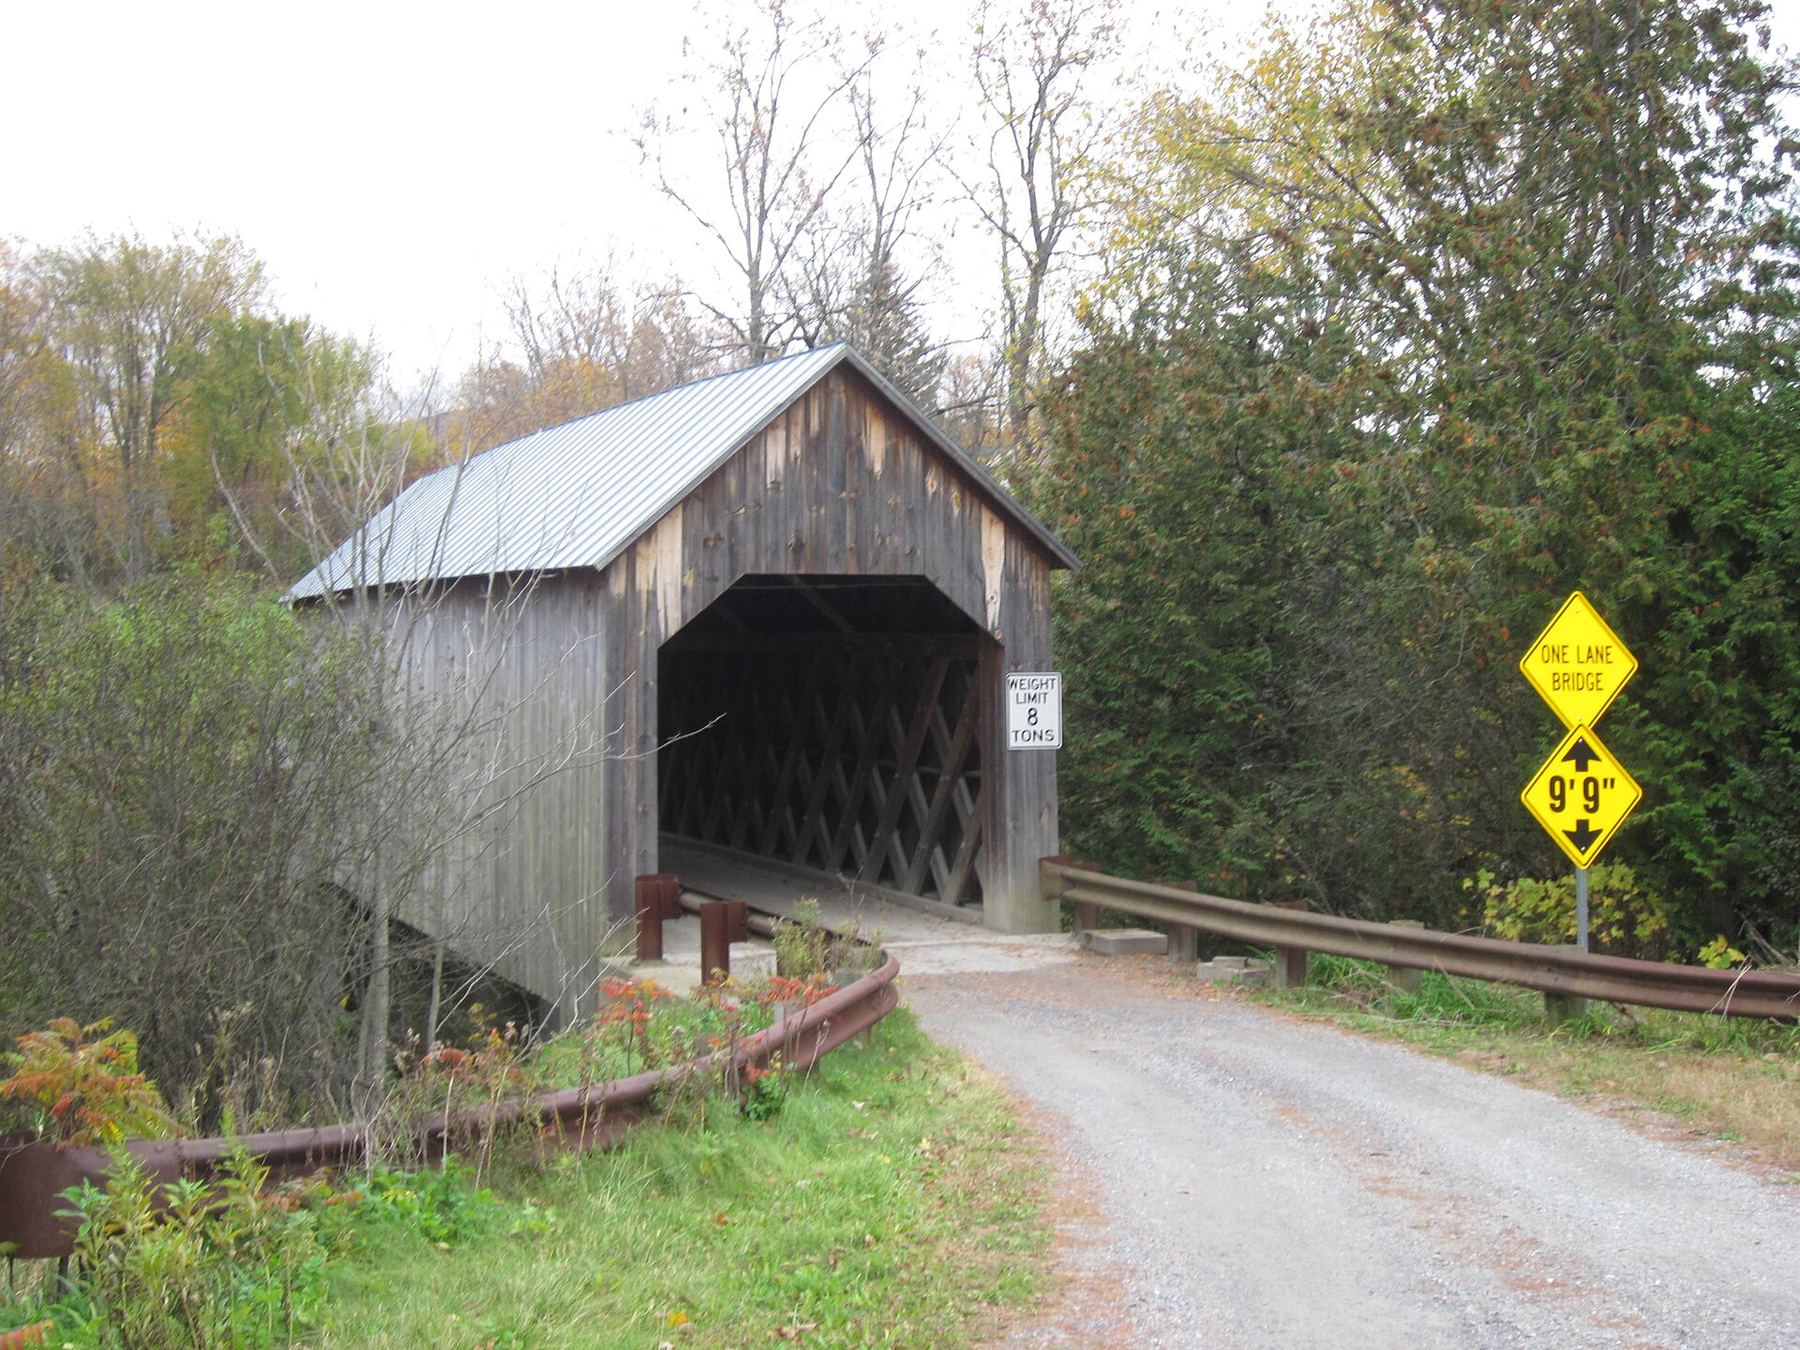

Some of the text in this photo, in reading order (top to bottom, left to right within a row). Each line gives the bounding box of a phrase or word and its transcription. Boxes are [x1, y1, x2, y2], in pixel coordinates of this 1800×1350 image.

[1541, 644, 1614, 664] ONE LANE
[1007, 677, 1056, 690] WEIGHT
[1552, 672, 1604, 691] BRIDGE
[1015, 692, 1048, 705] LIMIT
[1027, 707, 1038, 726] 8
[1012, 729, 1055, 743] TONS
